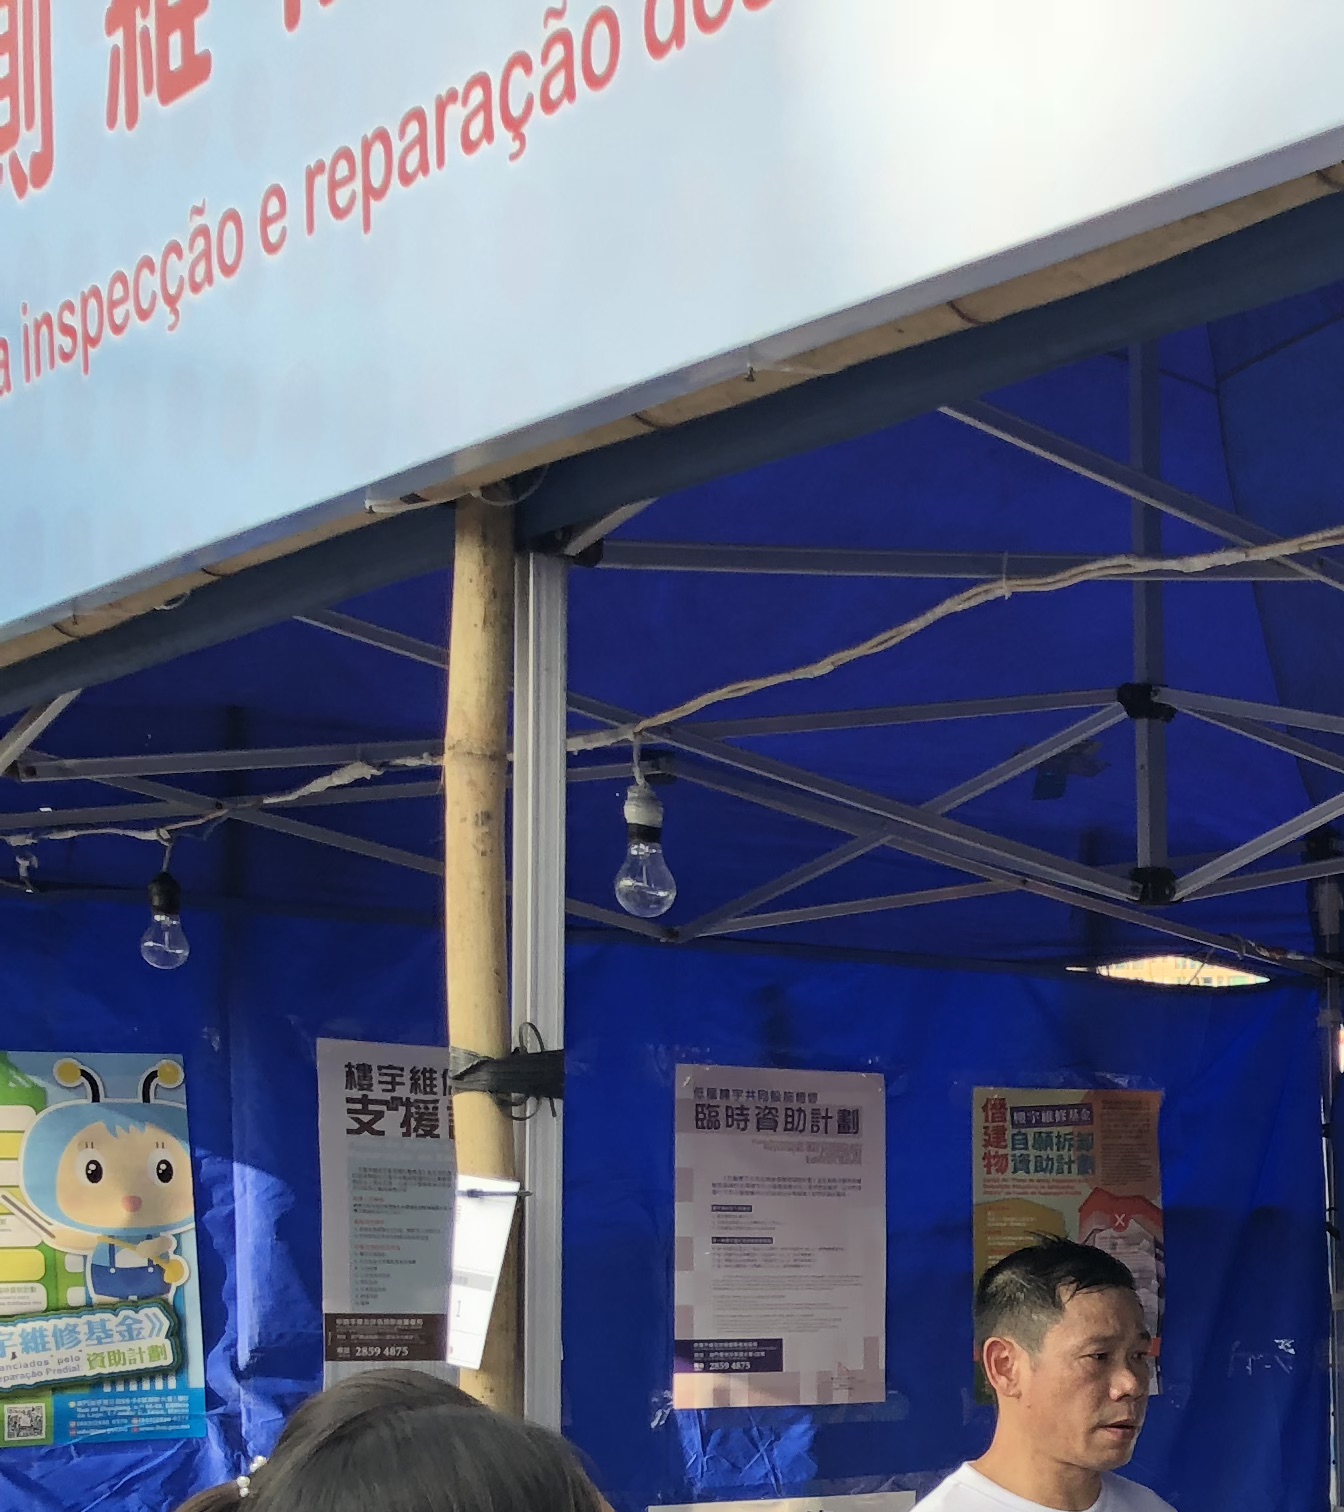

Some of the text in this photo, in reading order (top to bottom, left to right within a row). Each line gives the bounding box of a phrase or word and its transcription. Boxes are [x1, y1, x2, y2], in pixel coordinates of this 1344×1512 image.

[21, 198, 214, 384] inspecção
[259, 182, 287, 255] e
[304, 0, 621, 237] reparação
[344, 1061, 451, 1096] 樓宇維
[345, 1094, 455, 1139] 支援
[695, 1103, 860, 1135] 臨時資助計劃
[982, 1096, 1009, 1175] 僭建物
[1011, 1130, 1094, 1152] 自願拆卸
[1011, 1153, 1095, 1175] 資助計劃
[86, 1343, 168, 1371] 資助計劃
